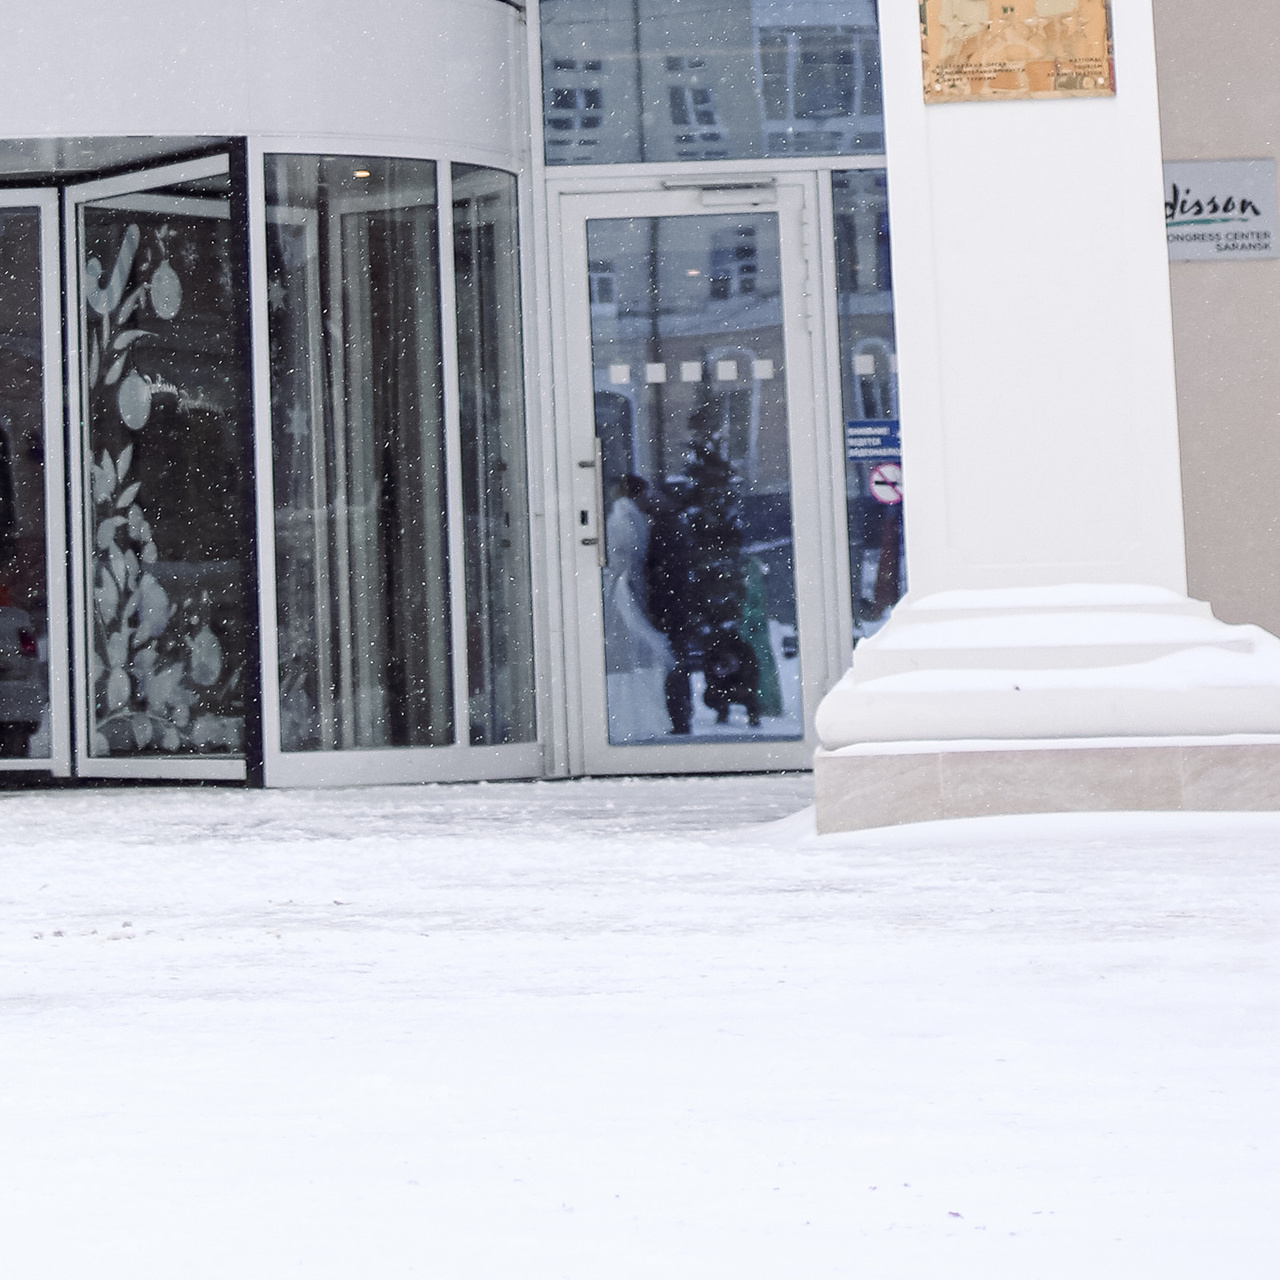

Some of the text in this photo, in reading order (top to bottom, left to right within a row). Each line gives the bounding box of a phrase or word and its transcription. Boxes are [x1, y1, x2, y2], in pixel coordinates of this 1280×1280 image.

[1165, 183, 1261, 220] disson
[1166, 230, 1272, 244] ONGRESS CENTER
[1216, 241, 1272, 252] SARANSK
